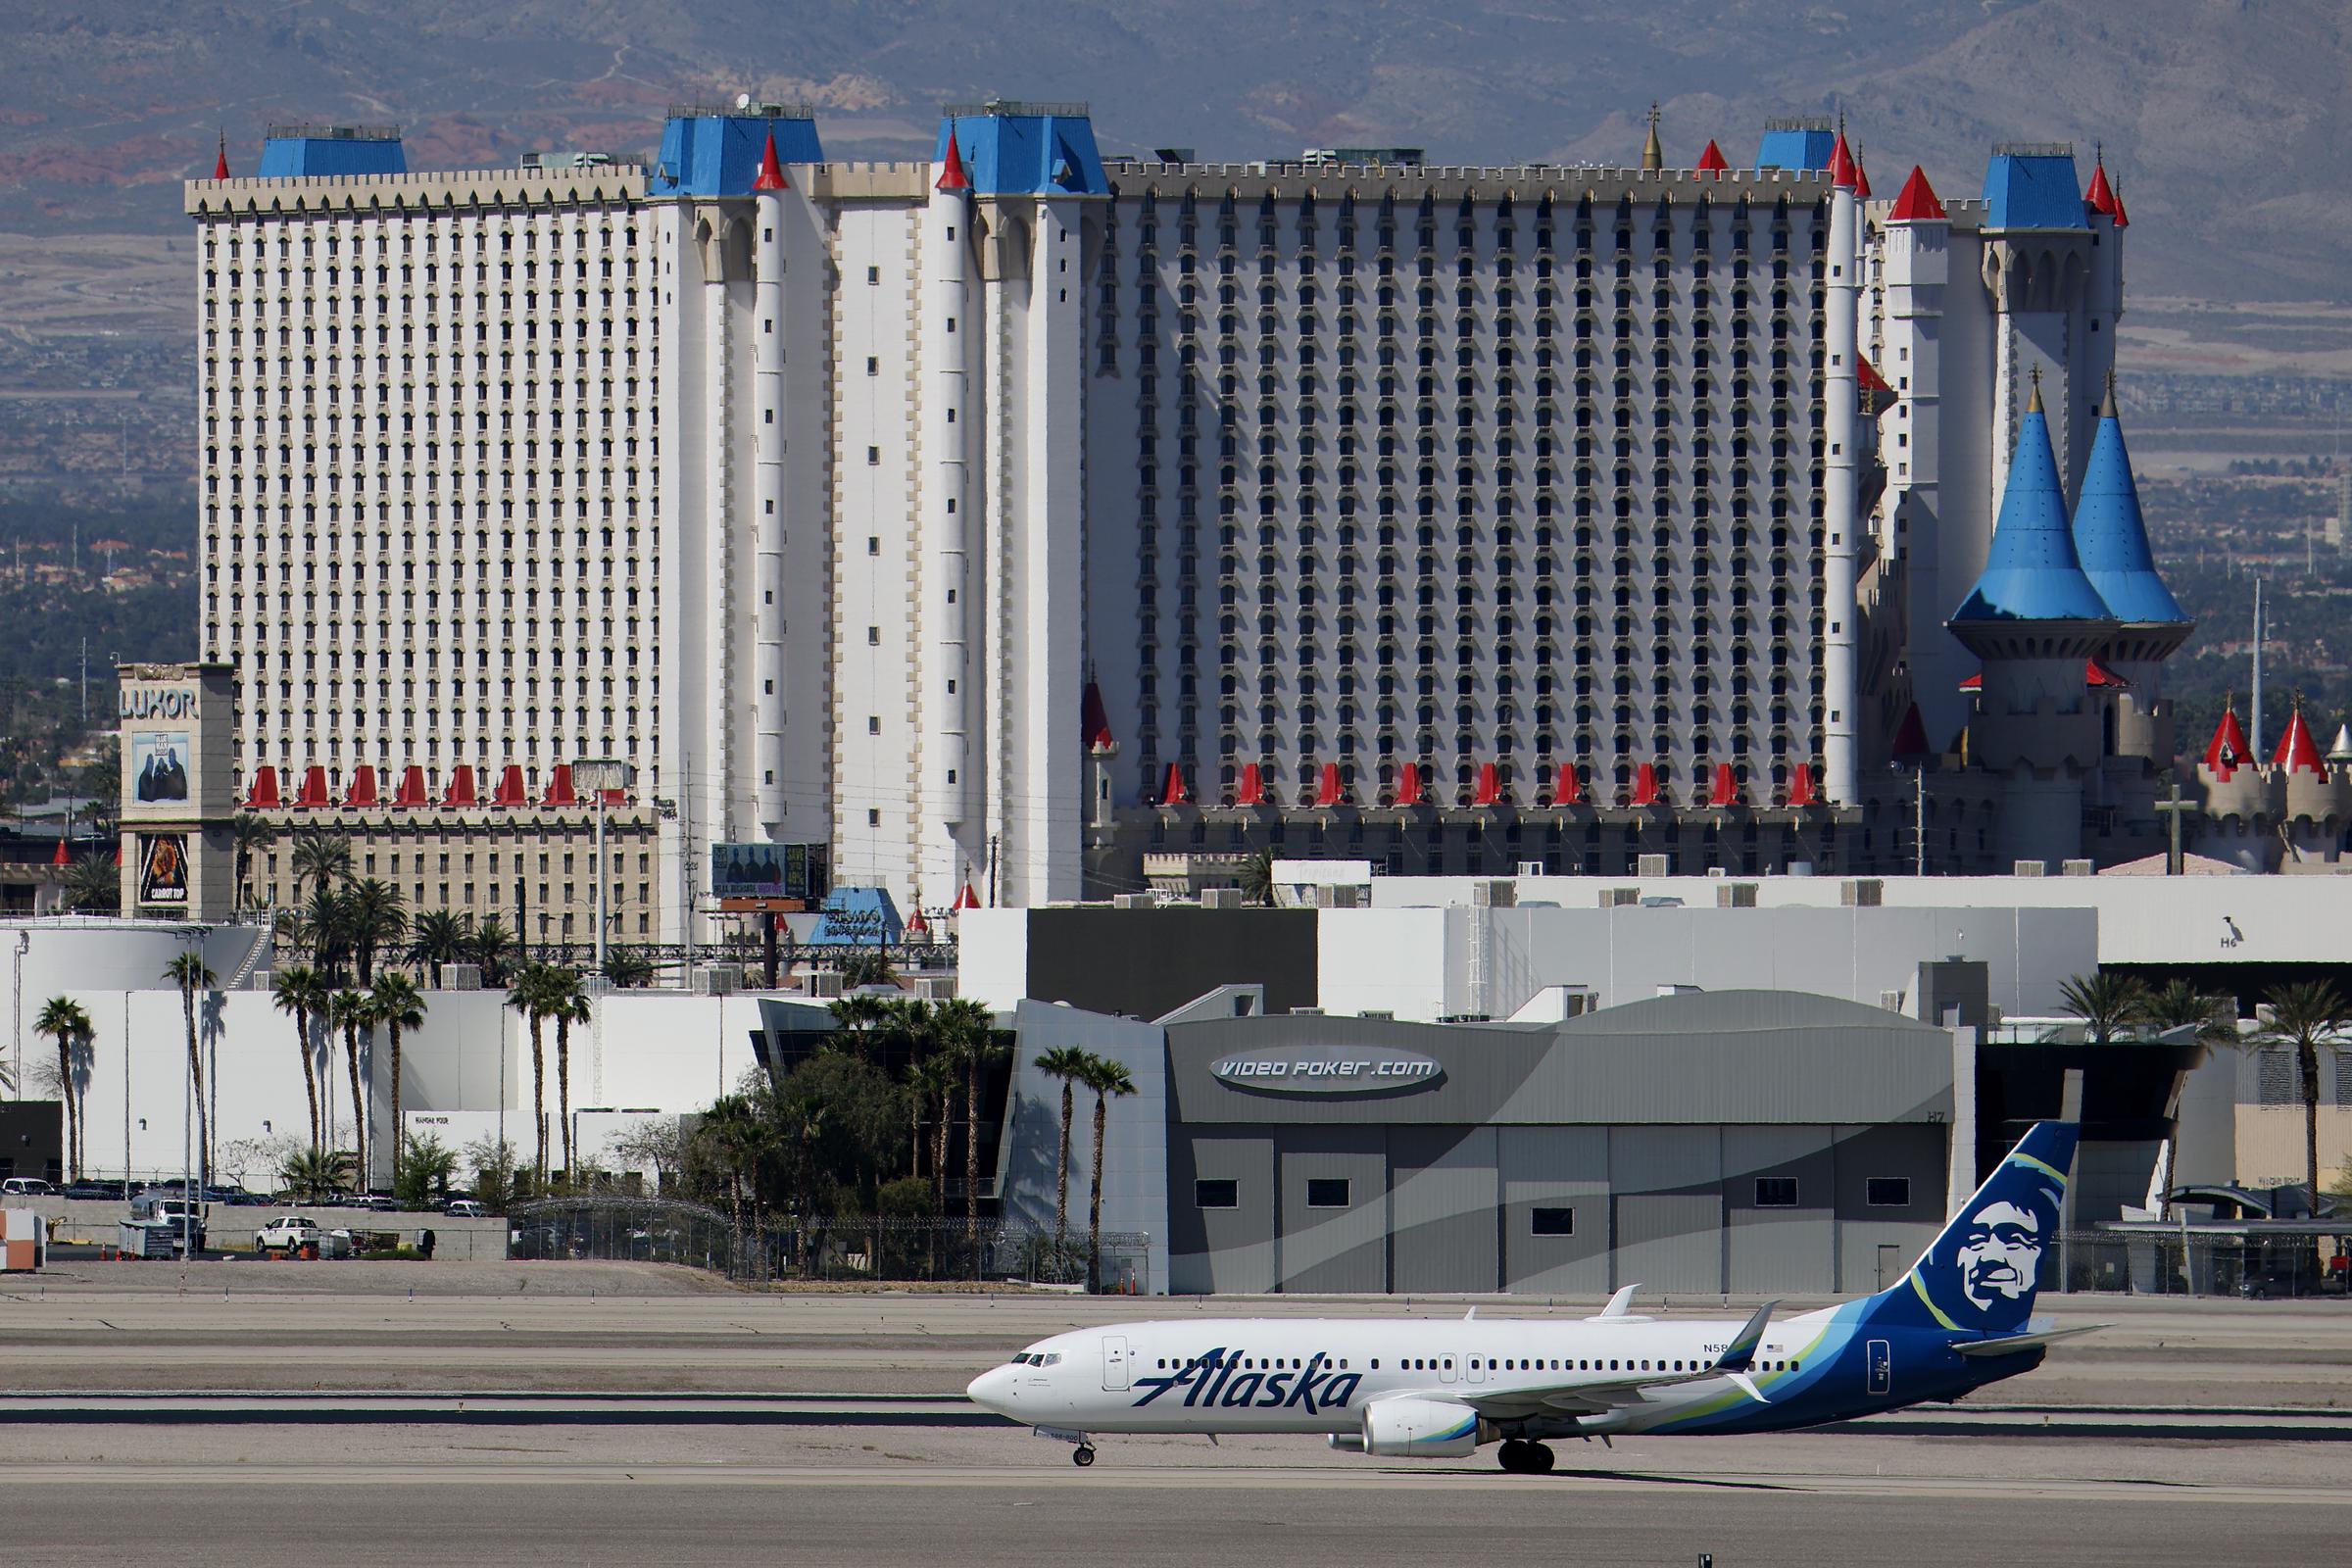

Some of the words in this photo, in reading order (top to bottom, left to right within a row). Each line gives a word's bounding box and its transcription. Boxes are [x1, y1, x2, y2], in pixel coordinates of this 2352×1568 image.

[119, 689, 199, 719] LUXOR
[172, 888, 184, 899] TOP
[2221, 938, 2237, 948] H6
[1131, 1348, 1363, 1415] Alaska
